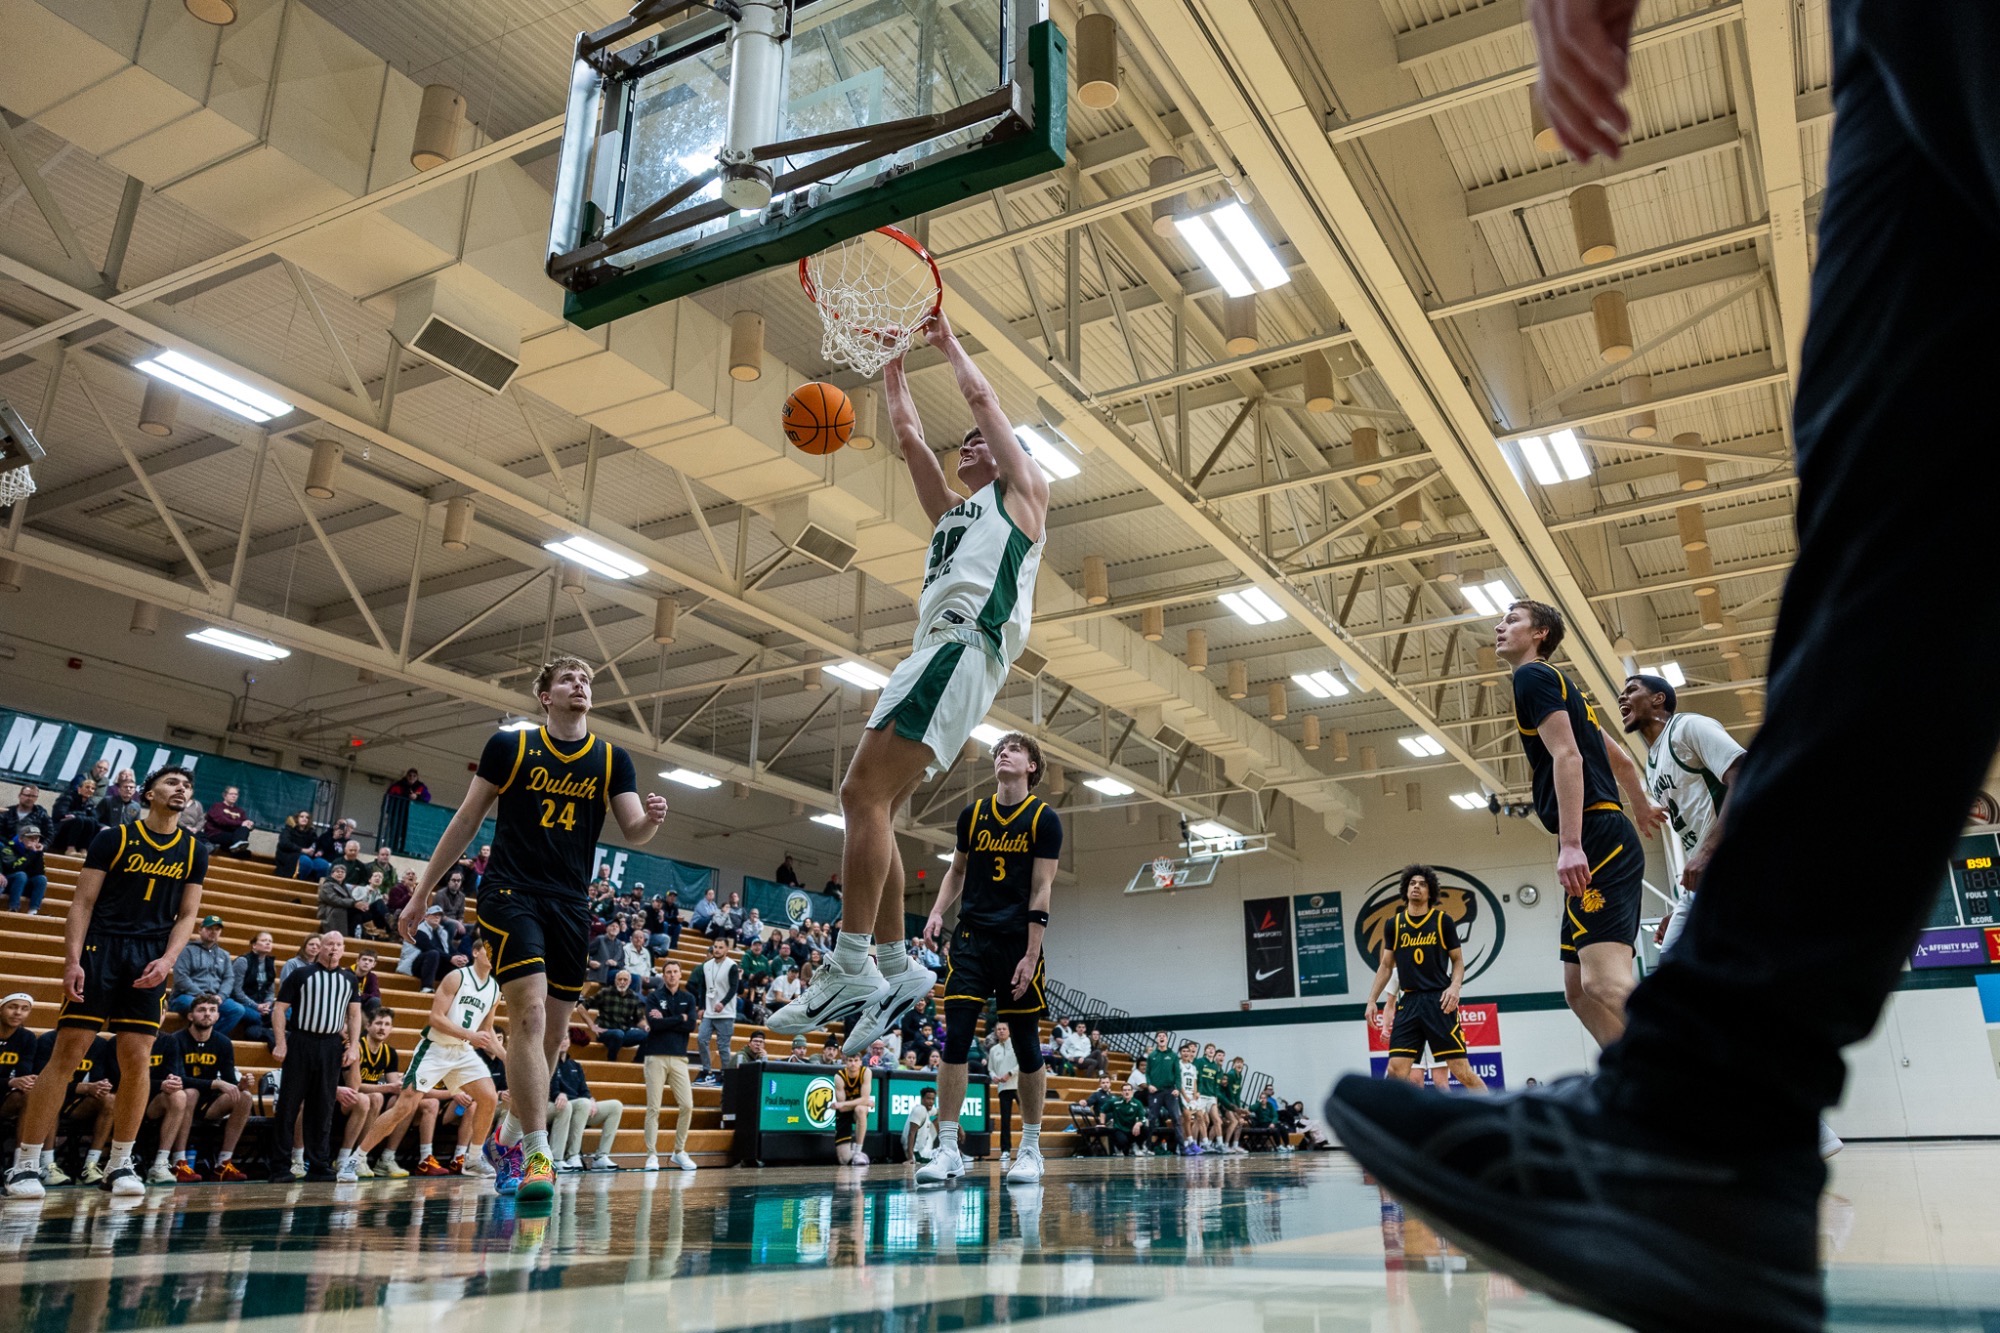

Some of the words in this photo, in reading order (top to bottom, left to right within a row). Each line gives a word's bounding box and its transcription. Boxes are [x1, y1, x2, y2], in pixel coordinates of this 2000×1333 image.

[526, 766, 598, 800] Duluth
[539, 798, 576, 831] 24
[975, 829, 1029, 853] Duluth
[123, 853, 185, 879] Duluth
[993, 856, 1007, 882] 3
[1966, 857, 1992, 869] BSU
[143, 878, 156, 901] 1
[1965, 890, 1988, 899] FOULS
[1970, 915, 1994, 924] SCORE
[1400, 931, 1438, 948] Duluth
[1929, 942, 1960, 951] AFFINITY
[1961, 941, 1979, 949] PLUS
[1413, 947, 1424, 965] 0
[462, 1009, 474, 1029] 5
[1474, 1064, 1498, 1078] LUS
[765, 1096, 778, 1105] Paul
[779, 1096, 800, 1108] Bunyan
